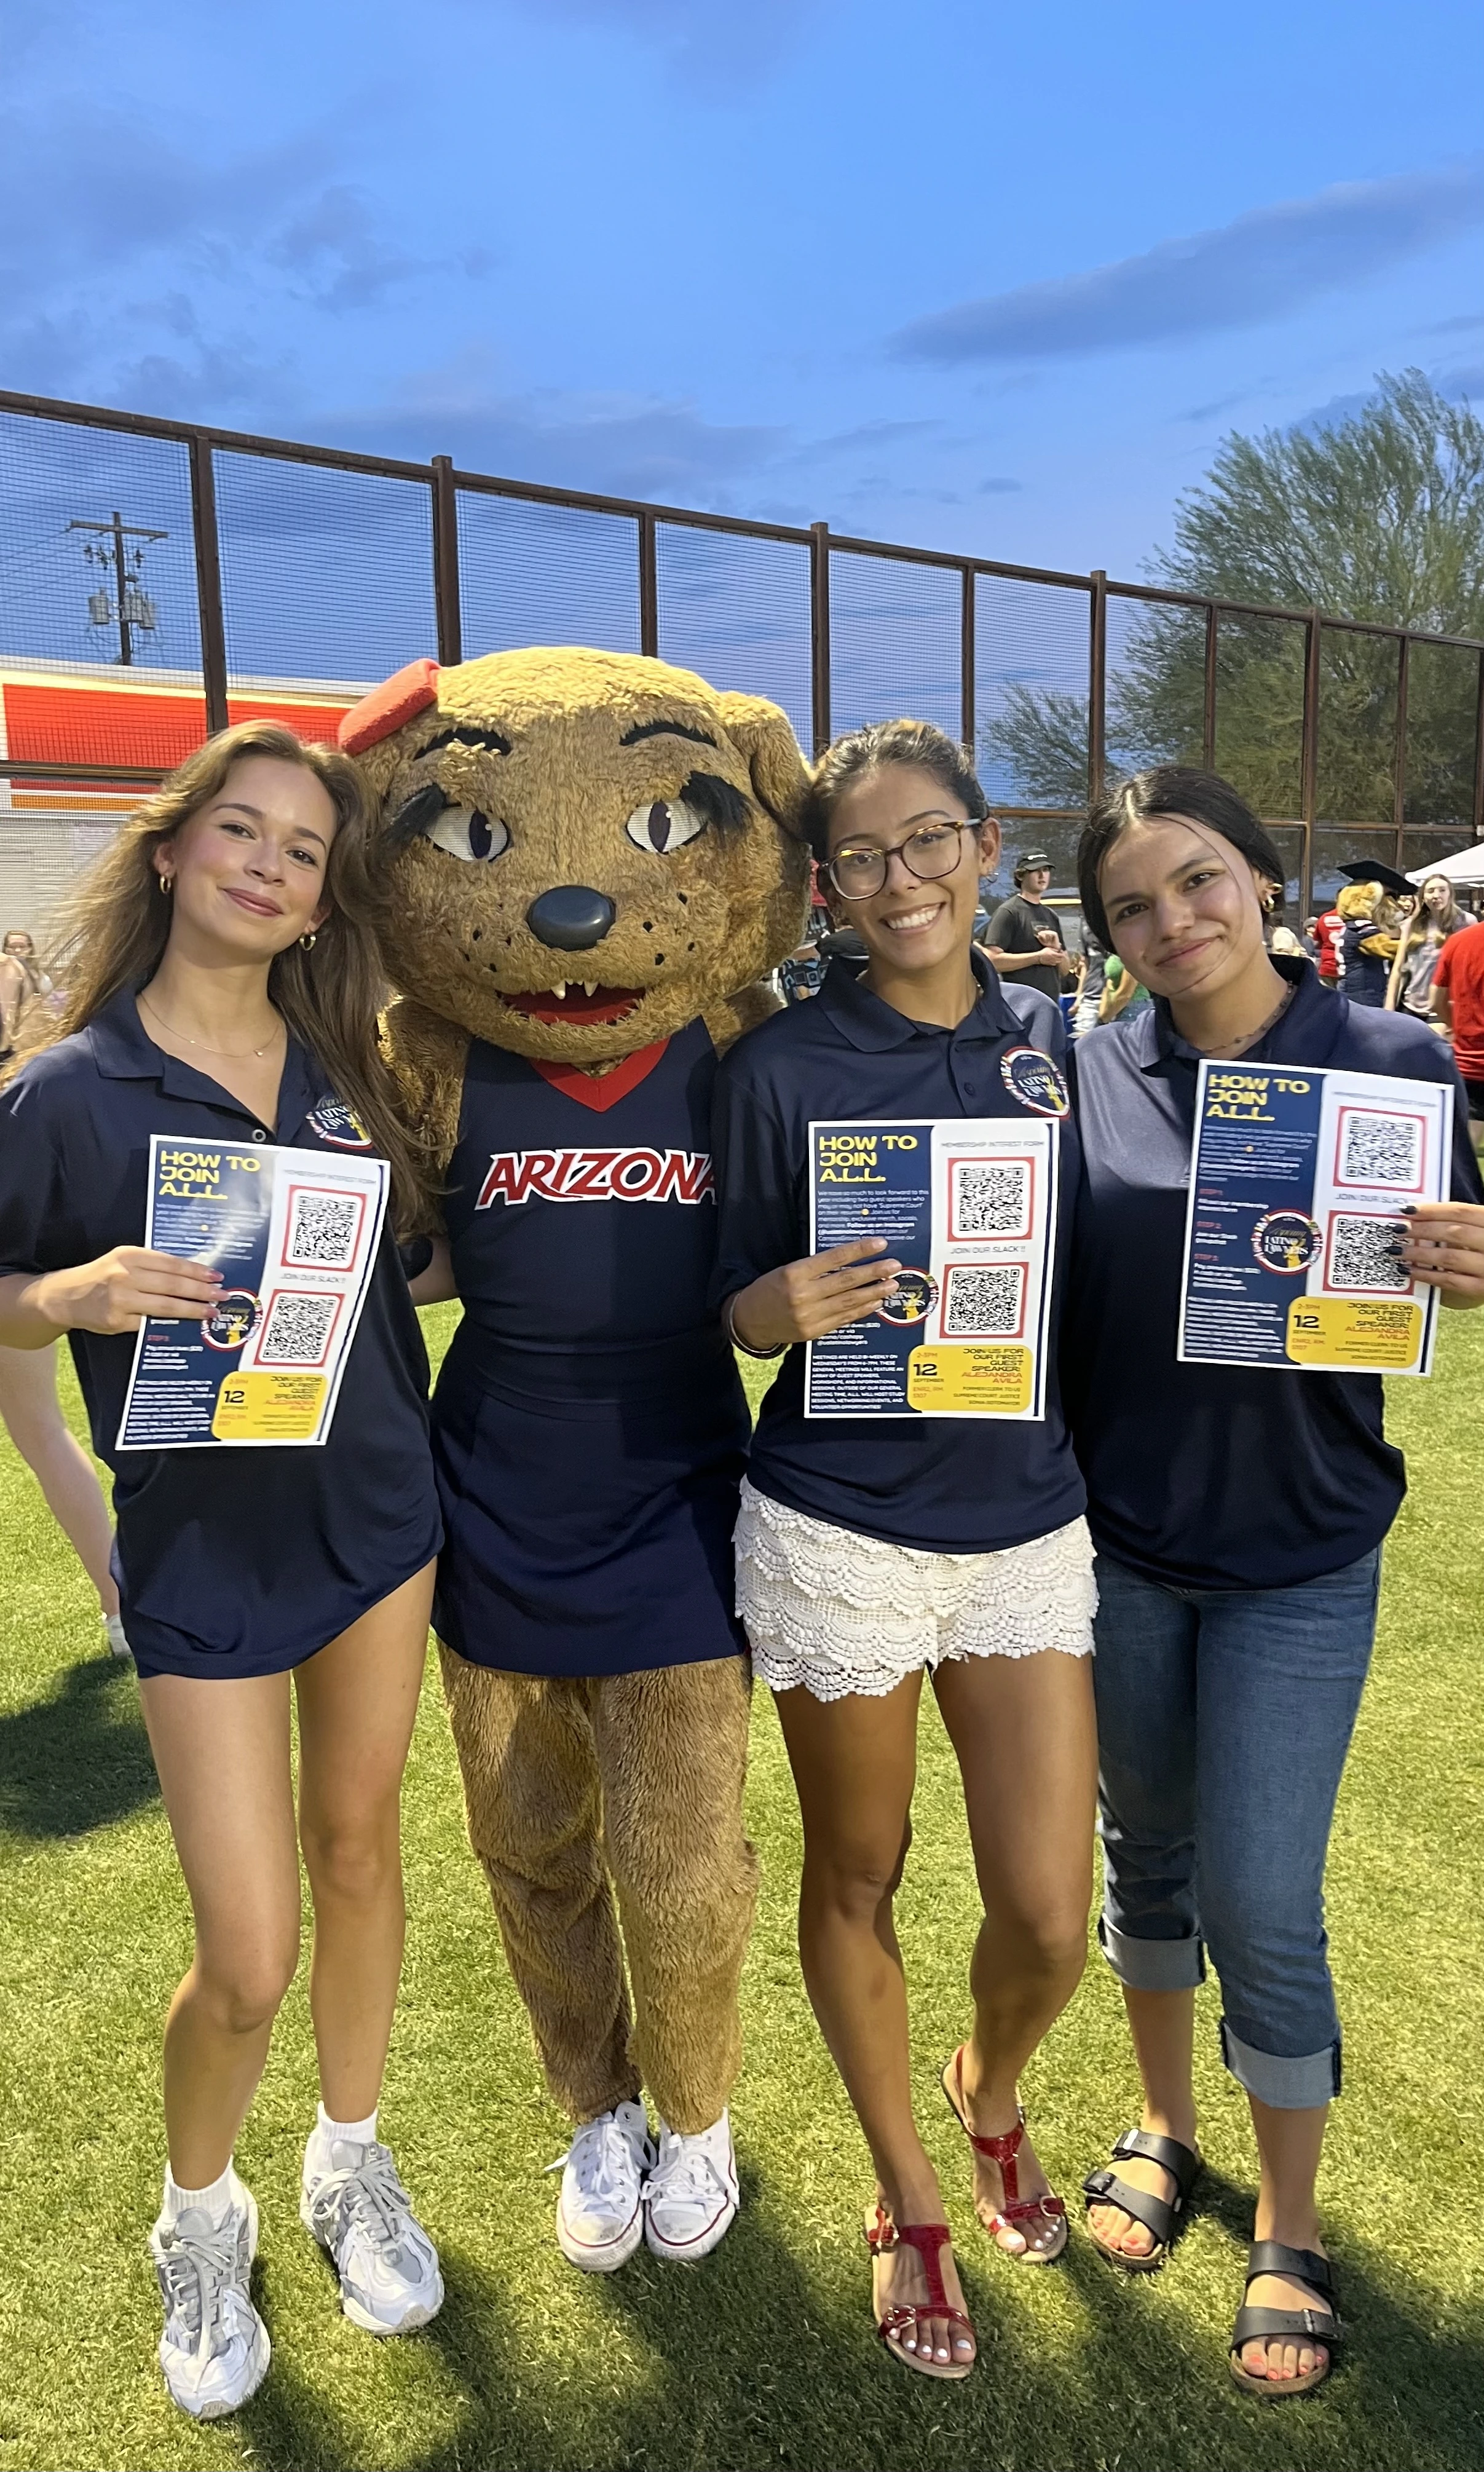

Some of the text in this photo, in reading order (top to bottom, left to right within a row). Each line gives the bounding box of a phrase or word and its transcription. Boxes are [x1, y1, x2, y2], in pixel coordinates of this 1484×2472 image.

[1208, 1075, 1310, 1094] HOW TO
[1207, 1089, 1268, 1105] JOIN
[1206, 1104, 1275, 1121] A.L.L.
[819, 1135, 917, 1151] HOW TO
[160, 1150, 261, 1172] HOW TO
[819, 1152, 877, 1166] JOIN
[160, 1166, 219, 1183] JOIN
[819, 1168, 886, 1182] A.L.L.
[159, 1182, 228, 1199] A.L.L.
[1293, 1315, 1319, 1329] 12
[914, 1364, 937, 1376] 12
[224, 1391, 245, 1403] 12
